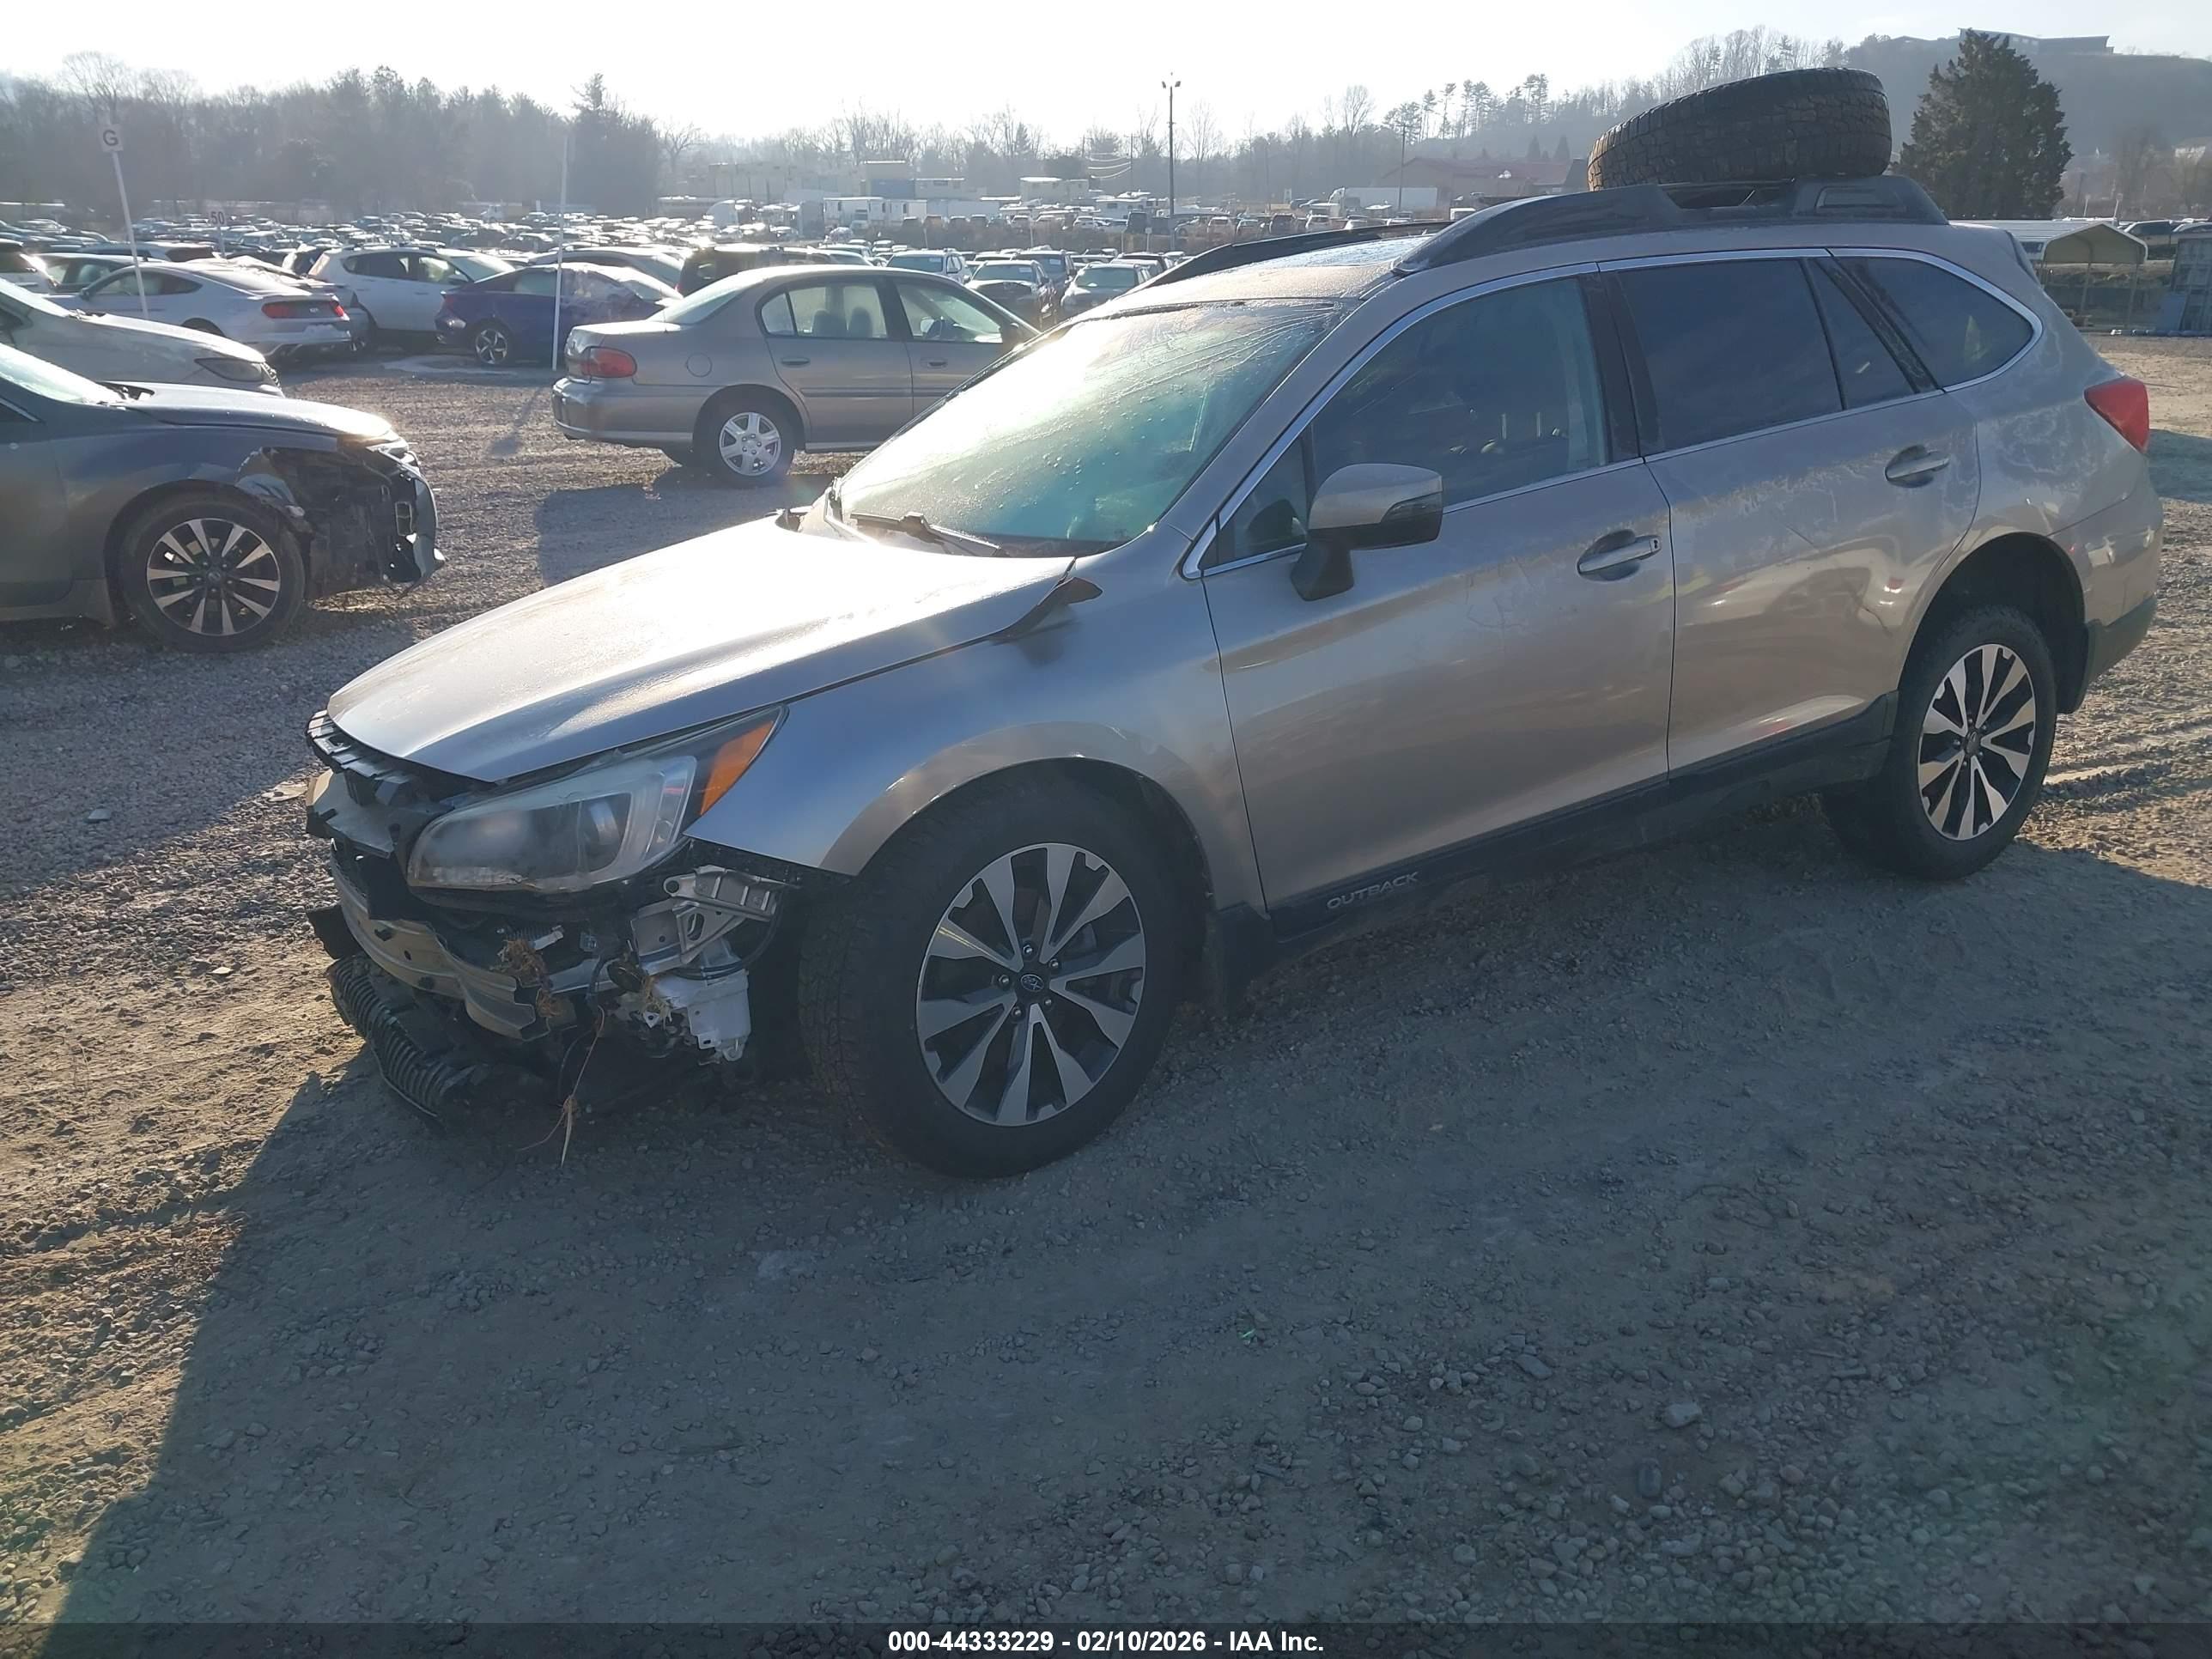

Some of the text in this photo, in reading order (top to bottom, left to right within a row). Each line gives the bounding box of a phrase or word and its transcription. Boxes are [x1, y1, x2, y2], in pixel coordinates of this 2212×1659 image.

[103, 130, 118, 146] G
[210, 211, 225, 224] 50
[1328, 872, 1418, 908] OUTBACK
